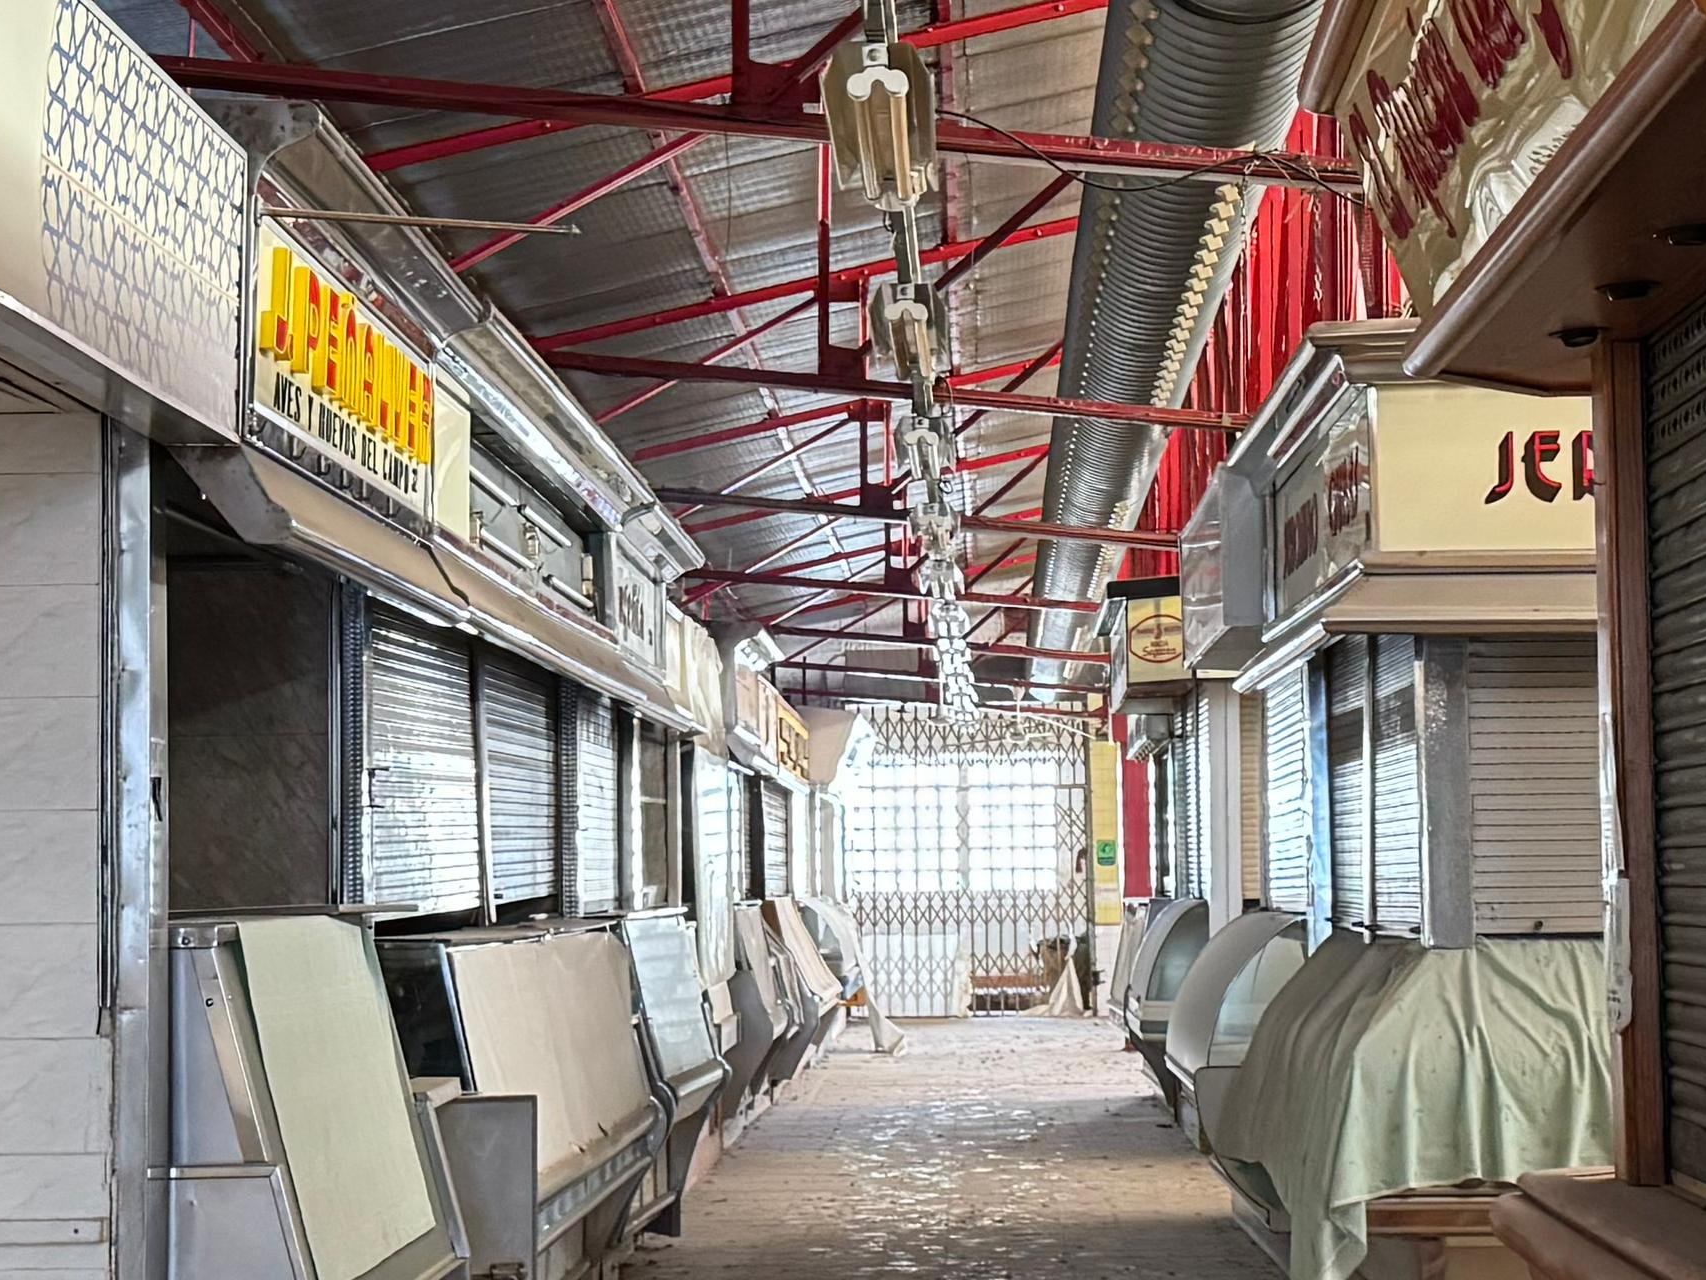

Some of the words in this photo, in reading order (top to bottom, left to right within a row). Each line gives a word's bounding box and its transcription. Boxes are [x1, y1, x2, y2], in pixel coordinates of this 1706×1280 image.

[272, 371, 303, 423] AVES
[307, 393, 315, 432] Y
[318, 402, 357, 460] HUEVOS
[360, 433, 379, 475] DEL
[382, 448, 410, 495] CAMPO
